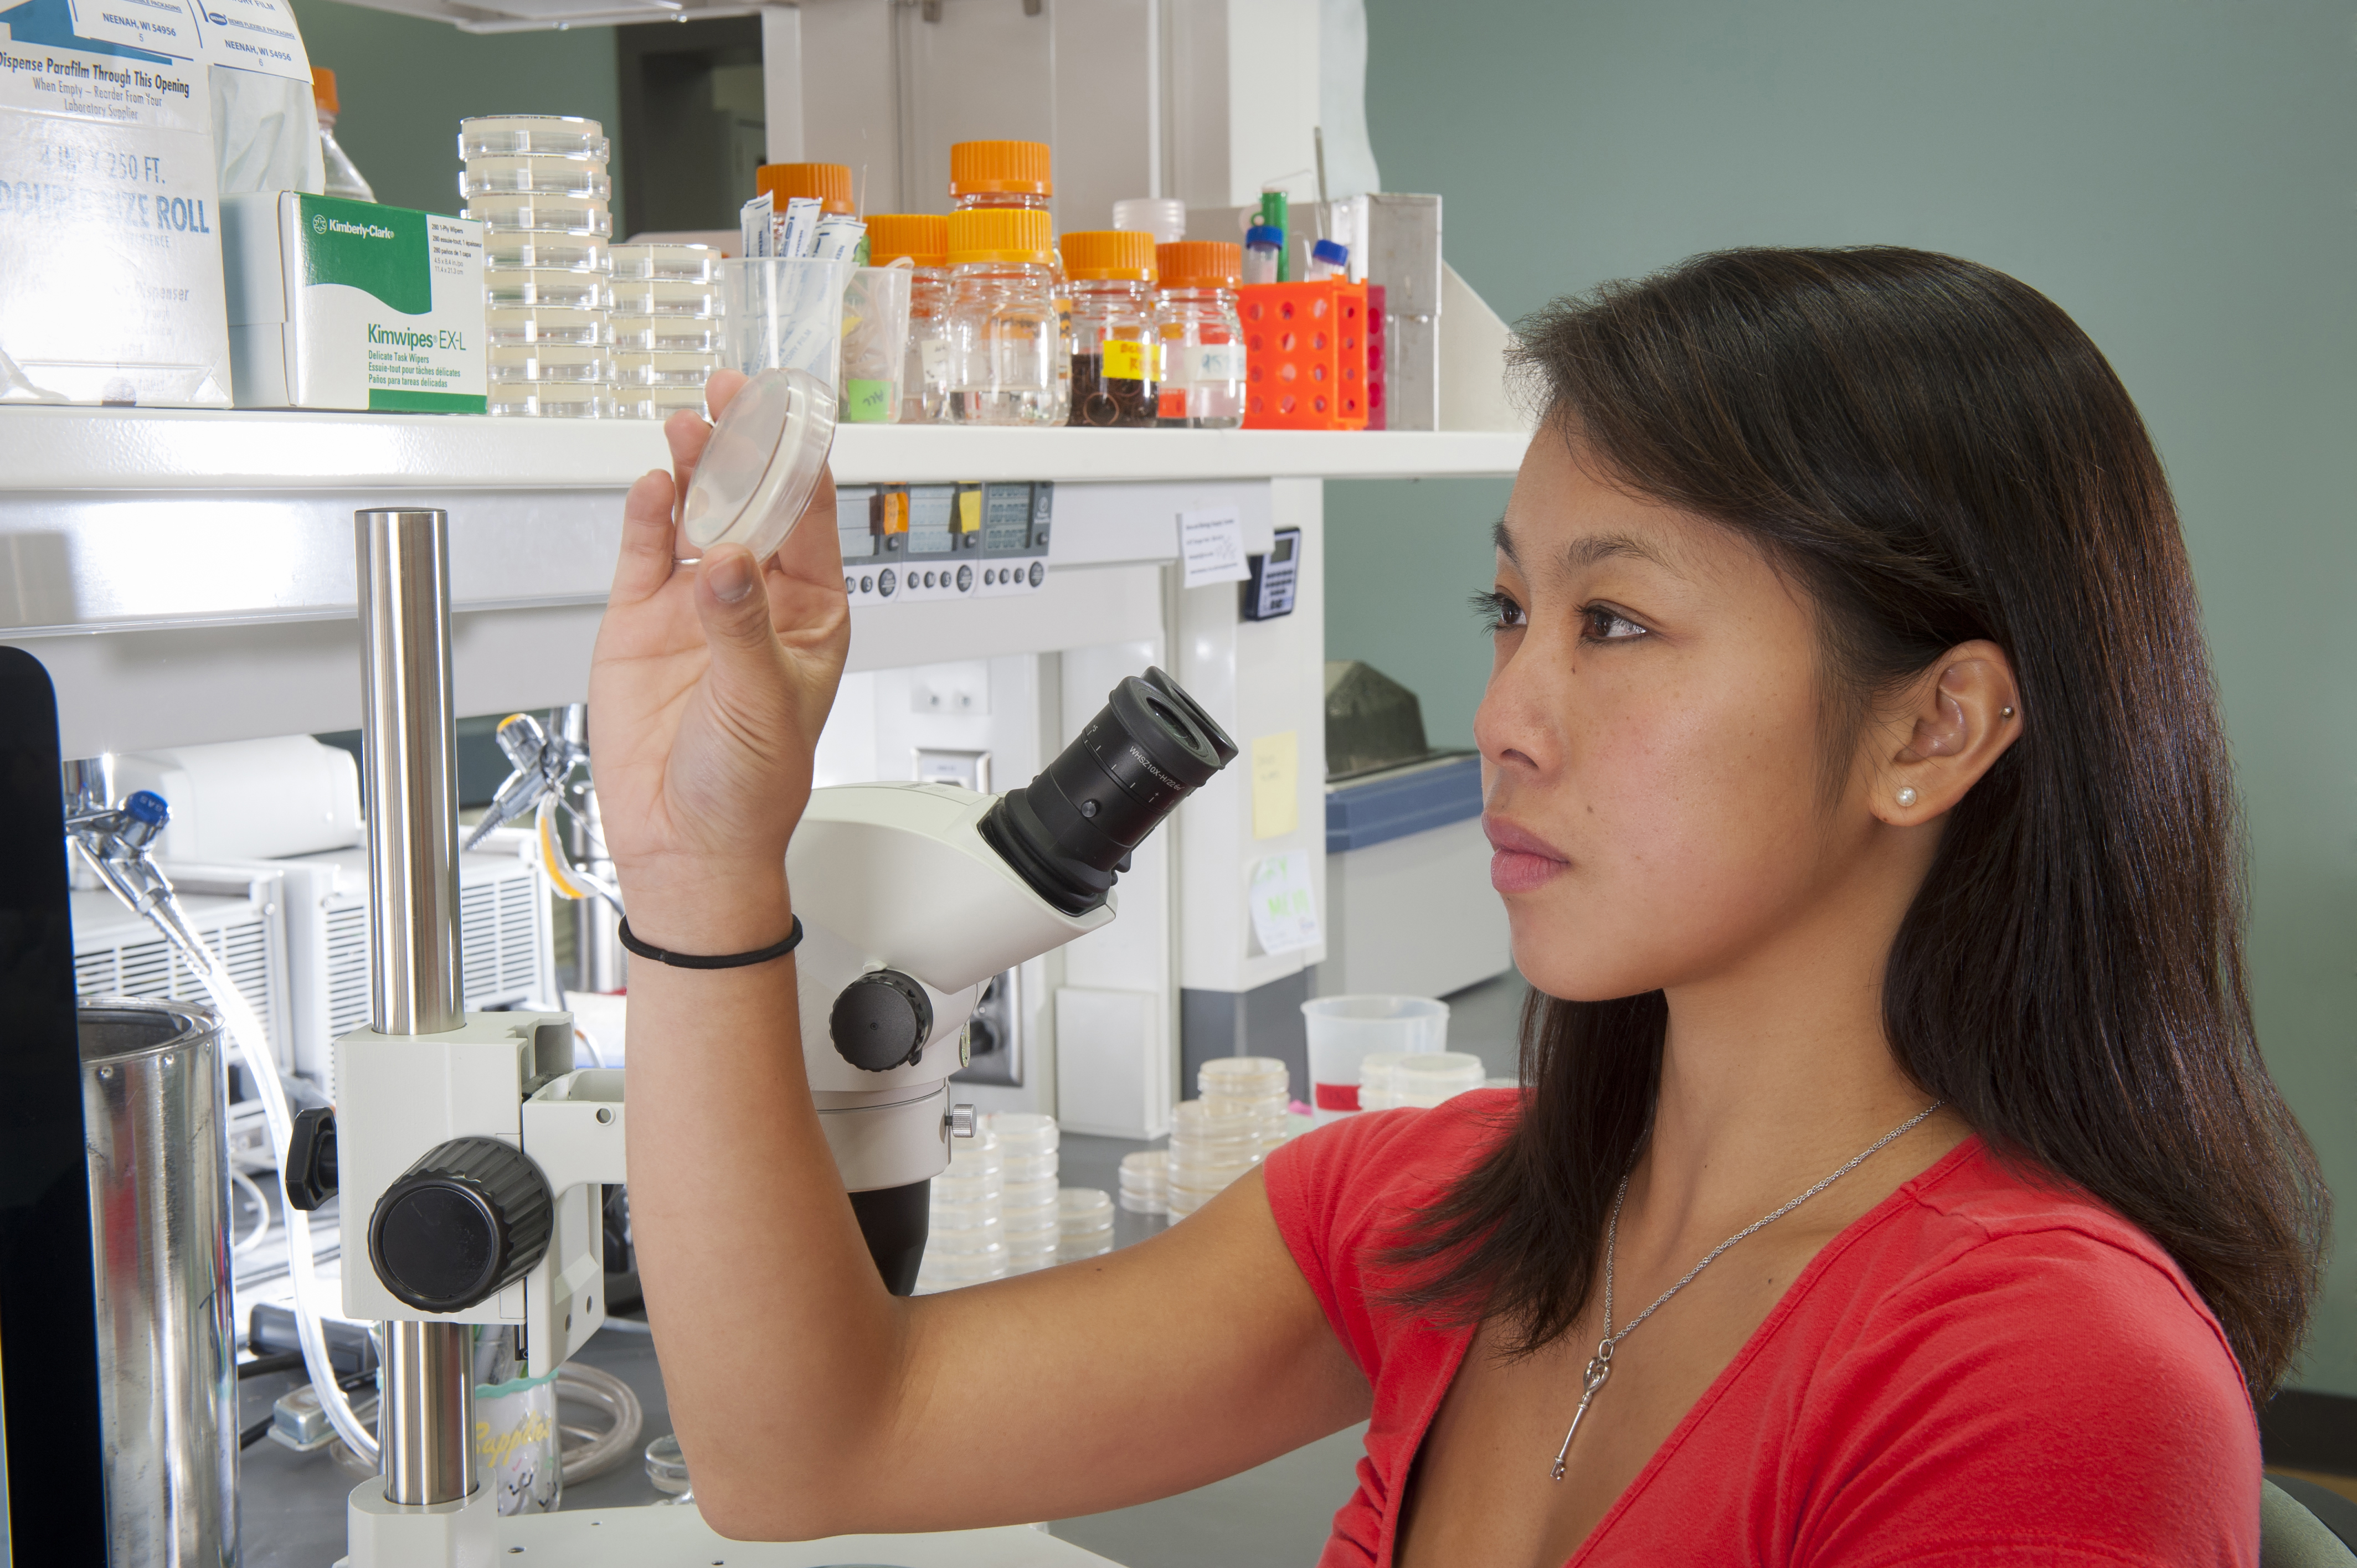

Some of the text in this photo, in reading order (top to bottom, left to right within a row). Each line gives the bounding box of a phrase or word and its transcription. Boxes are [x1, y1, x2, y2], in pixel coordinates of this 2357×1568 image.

[102, 12, 176, 37] NEENAH, WI 54956
[138, 32, 144, 42] 5
[224, 39, 292, 61] NEENAH, WI 54956
[259, 58, 264, 66] 6
[45, 56, 90, 79] Parafilm
[92, 63, 131, 89] Through
[132, 70, 152, 88] This
[154, 73, 190, 99] Opening
[32, 76, 56, 92] When
[58, 79, 83, 99] Empty
[94, 85, 123, 101] Reorder
[125, 90, 144, 104] From
[145, 92, 163, 107] Your
[64, 98, 138, 120] Laboratory Supplier
[143, 155, 166, 185] FT.
[156, 195, 210, 234] ROLL
[450, 225, 464, 235] Wipers
[439, 329, 467, 351] EX-L
[368, 350, 429, 365] Delicate Task Wipers
[368, 362, 401, 373] Essuie-tout
[402, 366, 415, 376] pour
[435, 366, 460, 378] délicates
[368, 373, 448, 388] Paños para tareas delicadas
[1129, 746, 1175, 787] WHSZ10X-H/22
